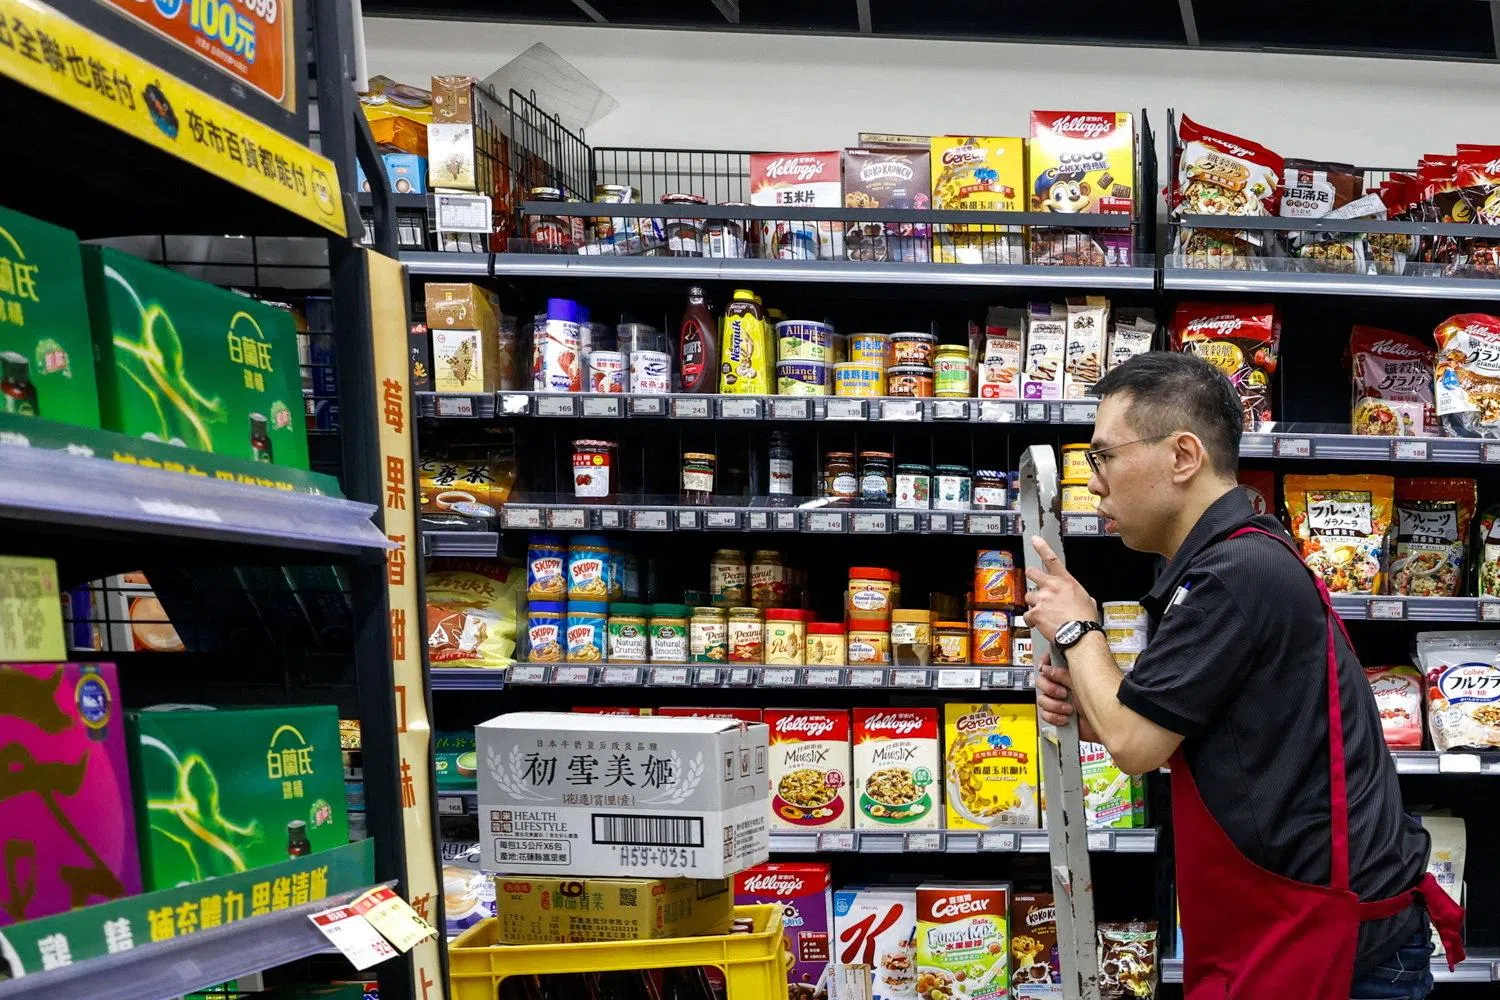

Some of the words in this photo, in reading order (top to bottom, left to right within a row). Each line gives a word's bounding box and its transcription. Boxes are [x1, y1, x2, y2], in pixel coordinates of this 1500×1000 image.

[1052, 114, 1111, 134] Kellogg's
[185, 109, 307, 197] 夜市百貨都能付
[766, 160, 824, 180] Kellogg's
[783, 190, 816, 205] 玉米片
[731, 320, 741, 362] Nesquik
[227, 331, 273, 373] 白蘭氏
[780, 365, 816, 377] Alliance
[457, 406, 471, 414] 109
[828, 521, 841, 529] 149
[872, 521, 885, 529] 149
[1402, 511, 1451, 528] フルーツ
[986, 523, 1000, 531] 105
[1410, 523, 1444, 535] グラノーラ
[534, 559, 561, 572] SKIPPY
[572, 562, 600, 577] SKIPPY
[531, 626, 555, 640] SKIPPY
[566, 627, 591, 641] SKIPPY
[616, 639, 643, 647] Natural
[654, 639, 682, 648] Natural
[614, 646, 646, 655] Crunchy
[654, 647, 682, 656] Smooth
[780, 675, 793, 683] 123
[776, 714, 834, 736] Kellogg's
[864, 713, 922, 735] Kellogg's
[266, 747, 314, 783] 白蘭氏
[521, 752, 676, 790] 初雪美姬
[448, 804, 461, 812] 168
[514, 811, 556, 822] HEALTH
[514, 822, 568, 833] LIFESTYLE
[743, 874, 804, 895] Kellogg's
[931, 896, 990, 918] Cerear
[840, 903, 904, 970] K
